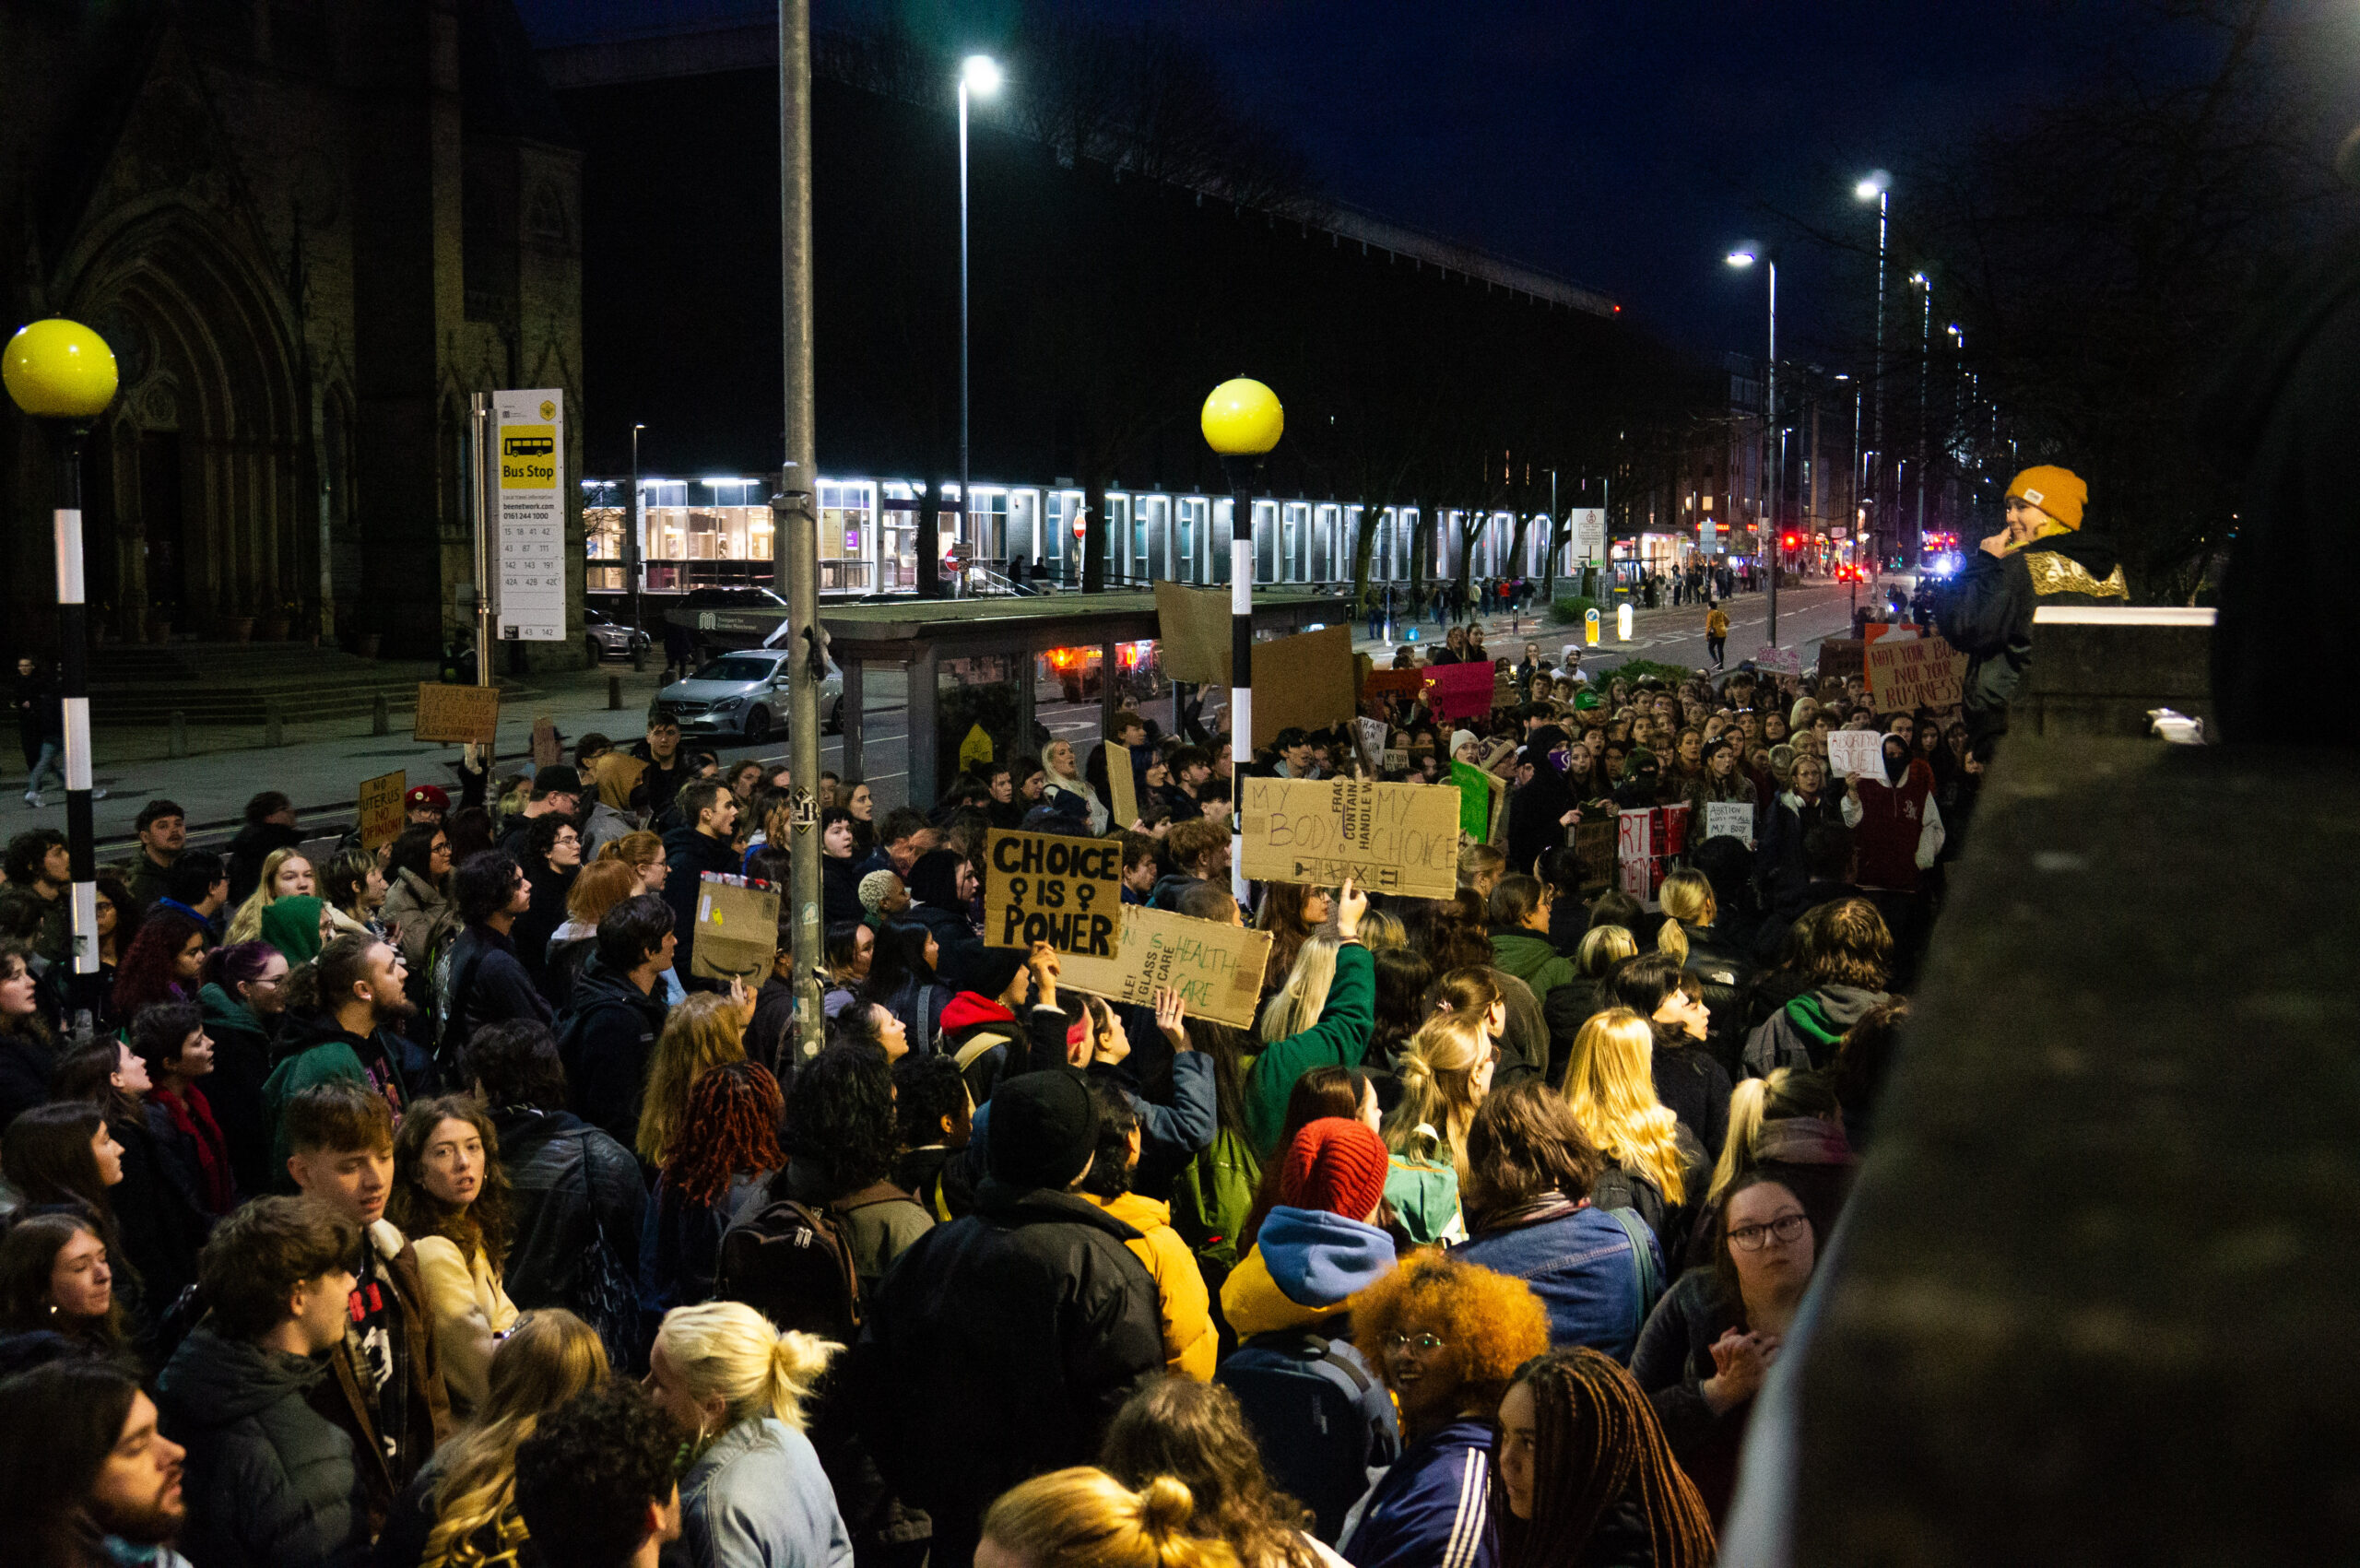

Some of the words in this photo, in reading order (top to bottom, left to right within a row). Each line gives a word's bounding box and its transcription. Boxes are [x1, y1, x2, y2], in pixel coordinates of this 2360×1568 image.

[503, 465, 524, 477] Bus
[526, 465, 553, 480] Stop
[1871, 649, 1894, 666] NOT
[1899, 643, 1927, 663] YOUR
[1894, 666, 1919, 684] NOT
[1924, 660, 1953, 679] YOUR
[1365, 731, 1375, 740] ON
[373, 778, 386, 791] NO
[1253, 784, 1291, 811] MY
[362, 788, 400, 811] UTERUS
[1376, 789, 1416, 826] MY
[375, 807, 389, 822] NO
[1359, 797, 1372, 850] HANDLE
[1711, 824, 1725, 833] MY
[1730, 825, 1747, 833] BODY
[1618, 814, 1647, 854] RT
[993, 837, 1119, 881] CHOICE
[1371, 828, 1457, 870] CHOICE
[1036, 880, 1065, 908] IS
[1004, 904, 1113, 957] POWER
[1138, 951, 1158, 996] GLASS
[1157, 946, 1174, 981] CARE
[1172, 973, 1214, 1007] CARE
